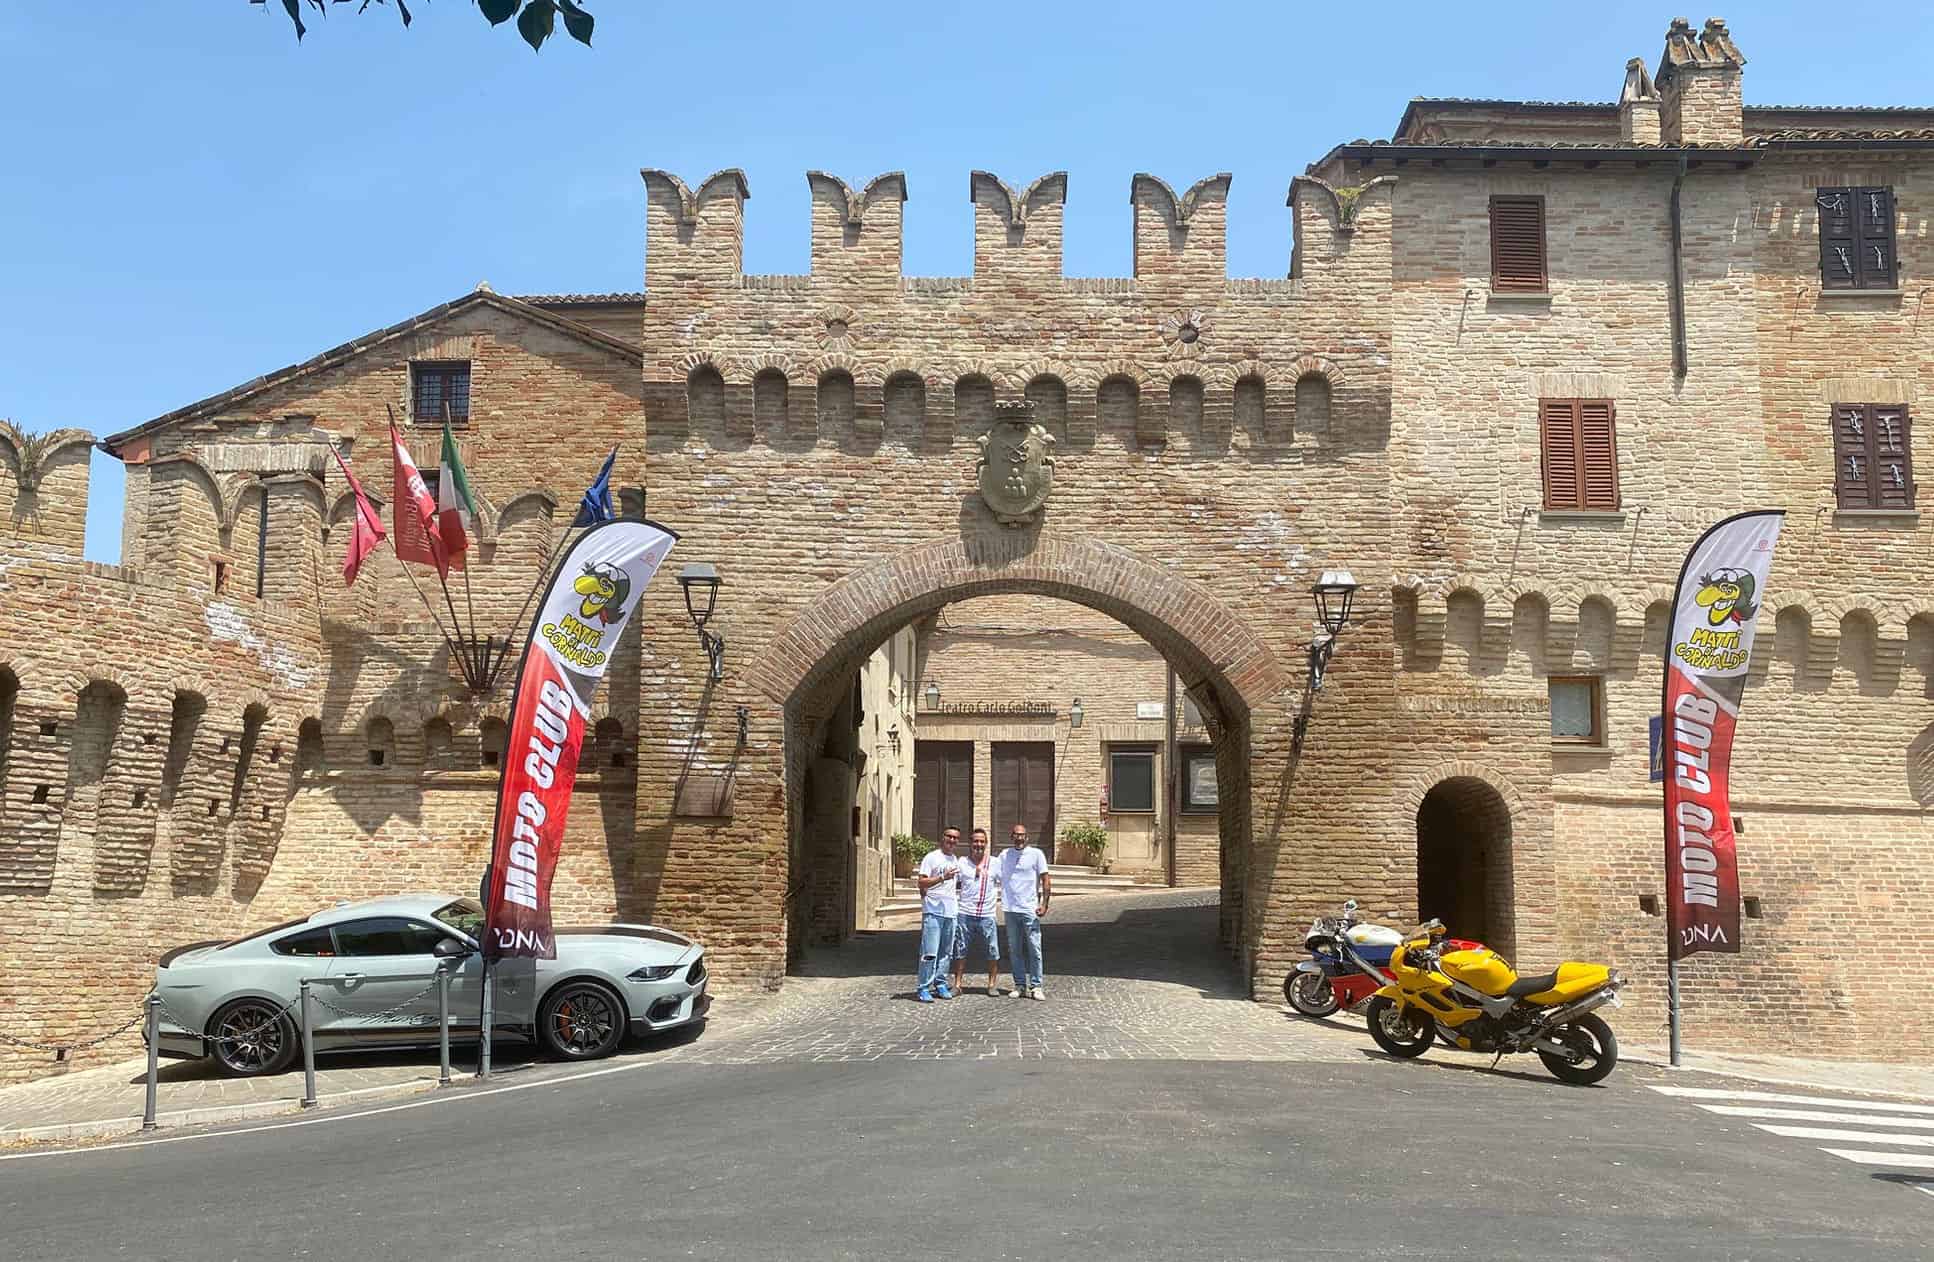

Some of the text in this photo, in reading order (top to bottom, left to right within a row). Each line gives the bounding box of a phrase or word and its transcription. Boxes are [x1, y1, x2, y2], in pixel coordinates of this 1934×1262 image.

[503, 680, 574, 910] MOTO CLUB
[1674, 693, 1719, 908] MOTO CLUB
[493, 927, 546, 951] DNA
[1680, 923, 1728, 946] DNA
